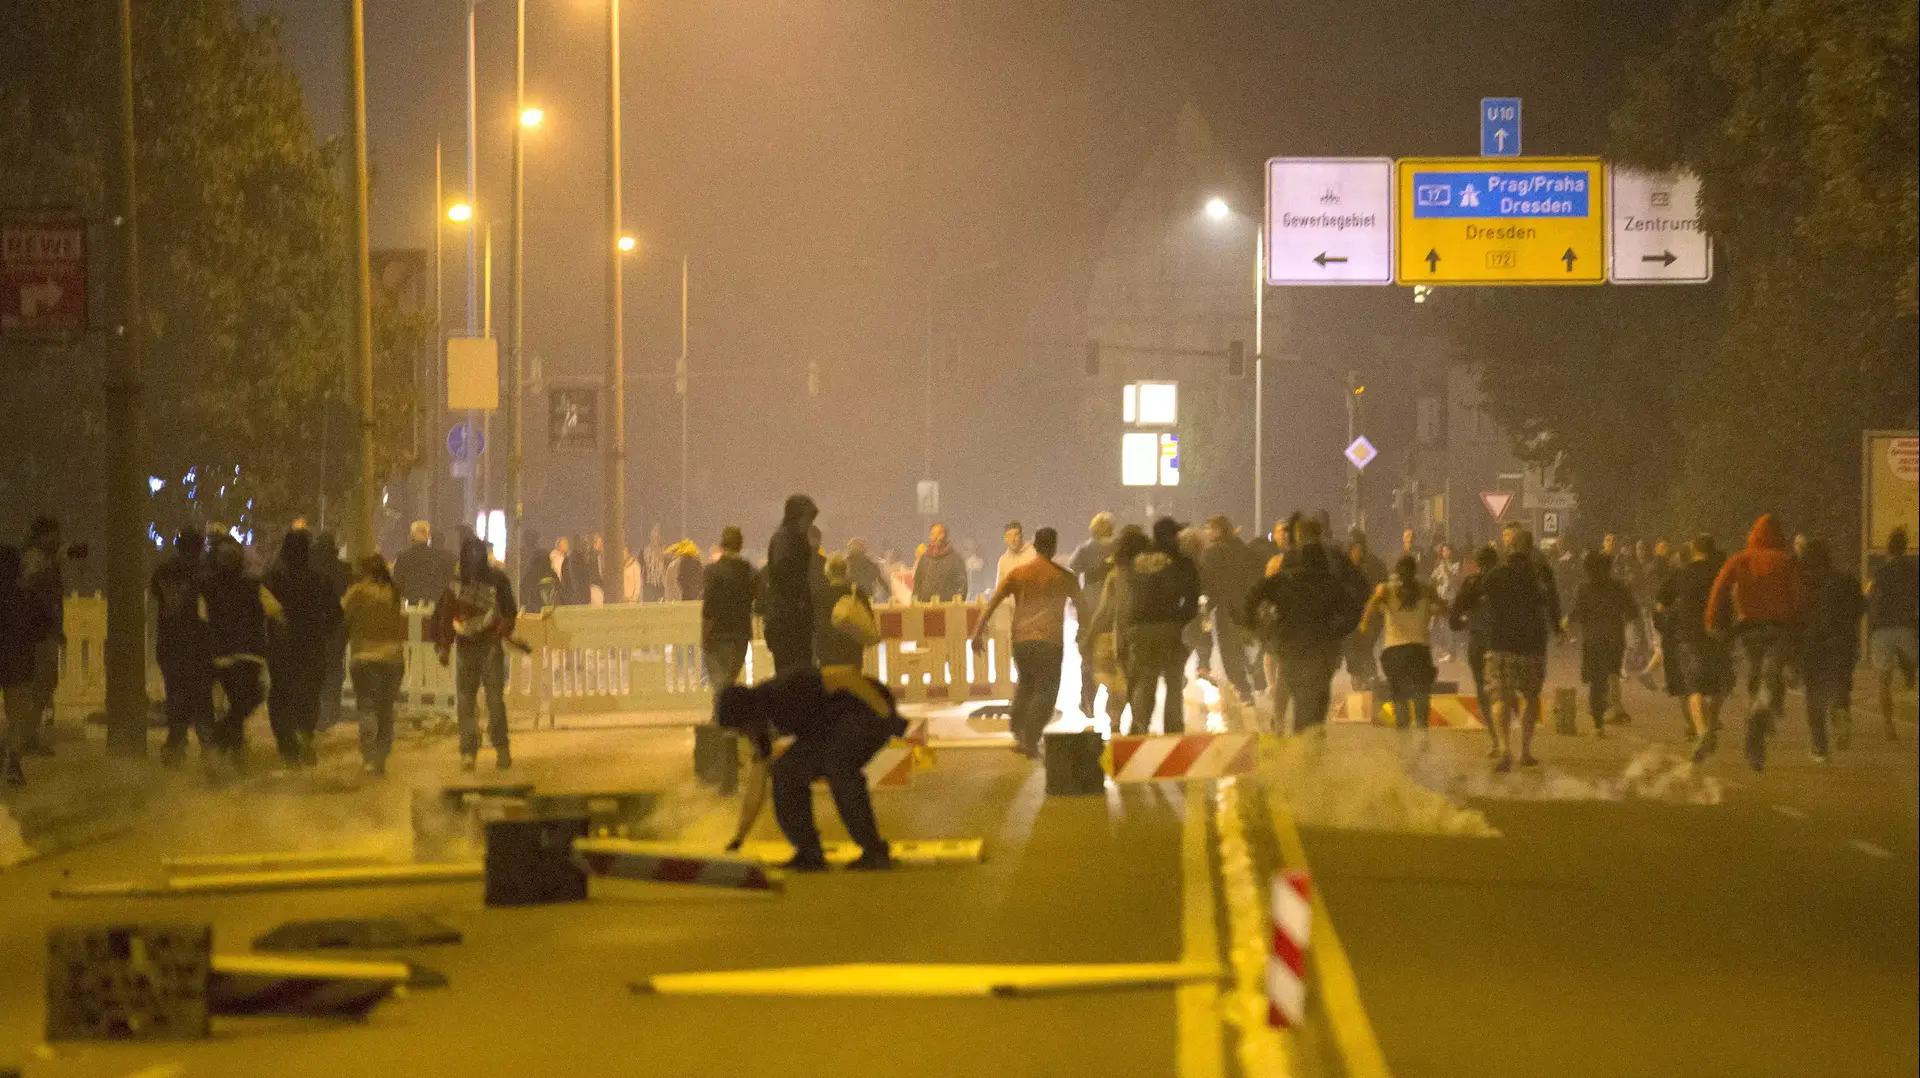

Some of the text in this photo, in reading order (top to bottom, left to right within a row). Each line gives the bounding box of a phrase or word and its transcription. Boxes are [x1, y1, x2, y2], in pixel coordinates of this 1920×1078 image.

[1488, 176, 1584, 195] Prag/Praha
[1501, 198, 1572, 213] Dresden
[1283, 212, 1376, 231] Gewerbegebiet
[1466, 224, 1536, 240] Dresden
[1491, 253, 1510, 265] 172
